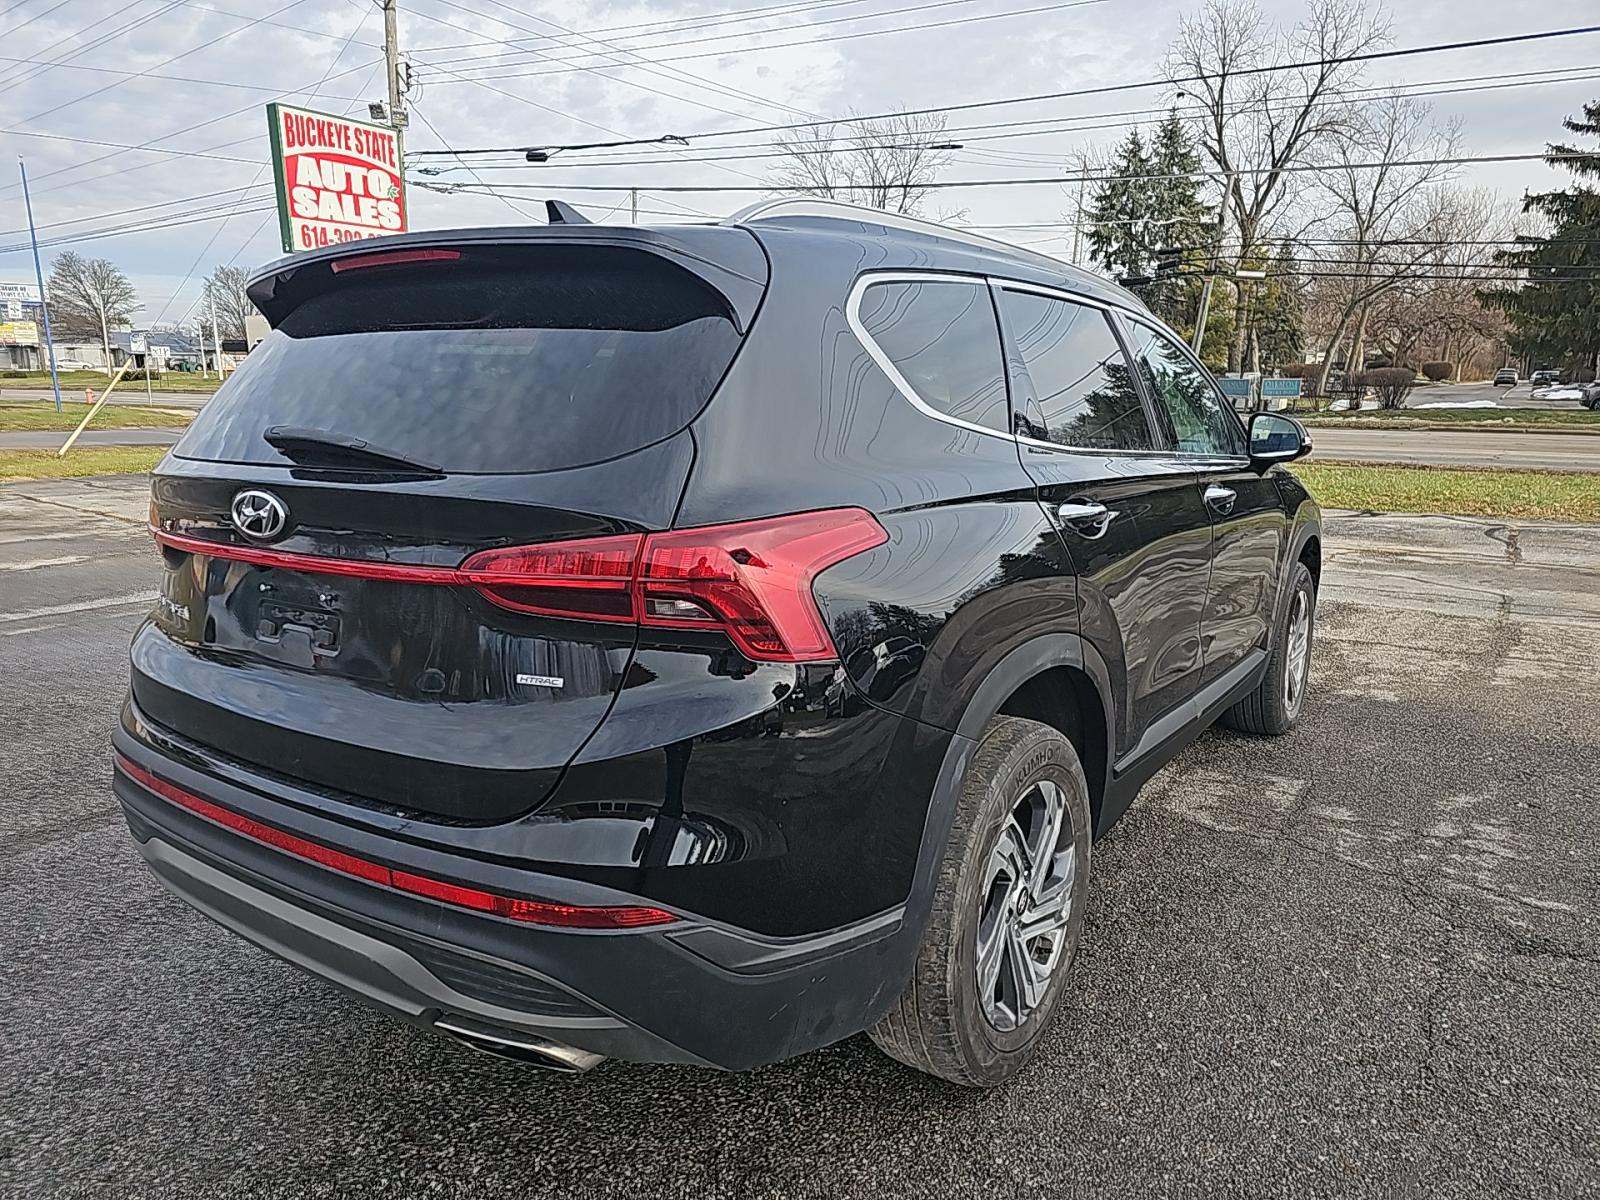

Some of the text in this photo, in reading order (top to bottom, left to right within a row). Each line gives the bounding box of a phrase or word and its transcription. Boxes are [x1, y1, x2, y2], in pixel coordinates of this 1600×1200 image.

[283, 111, 396, 168] BUCKEYE STATE
[295, 155, 392, 200] AUTO
[291, 186, 402, 230] SALES
[519, 676, 560, 686] HTRAC
